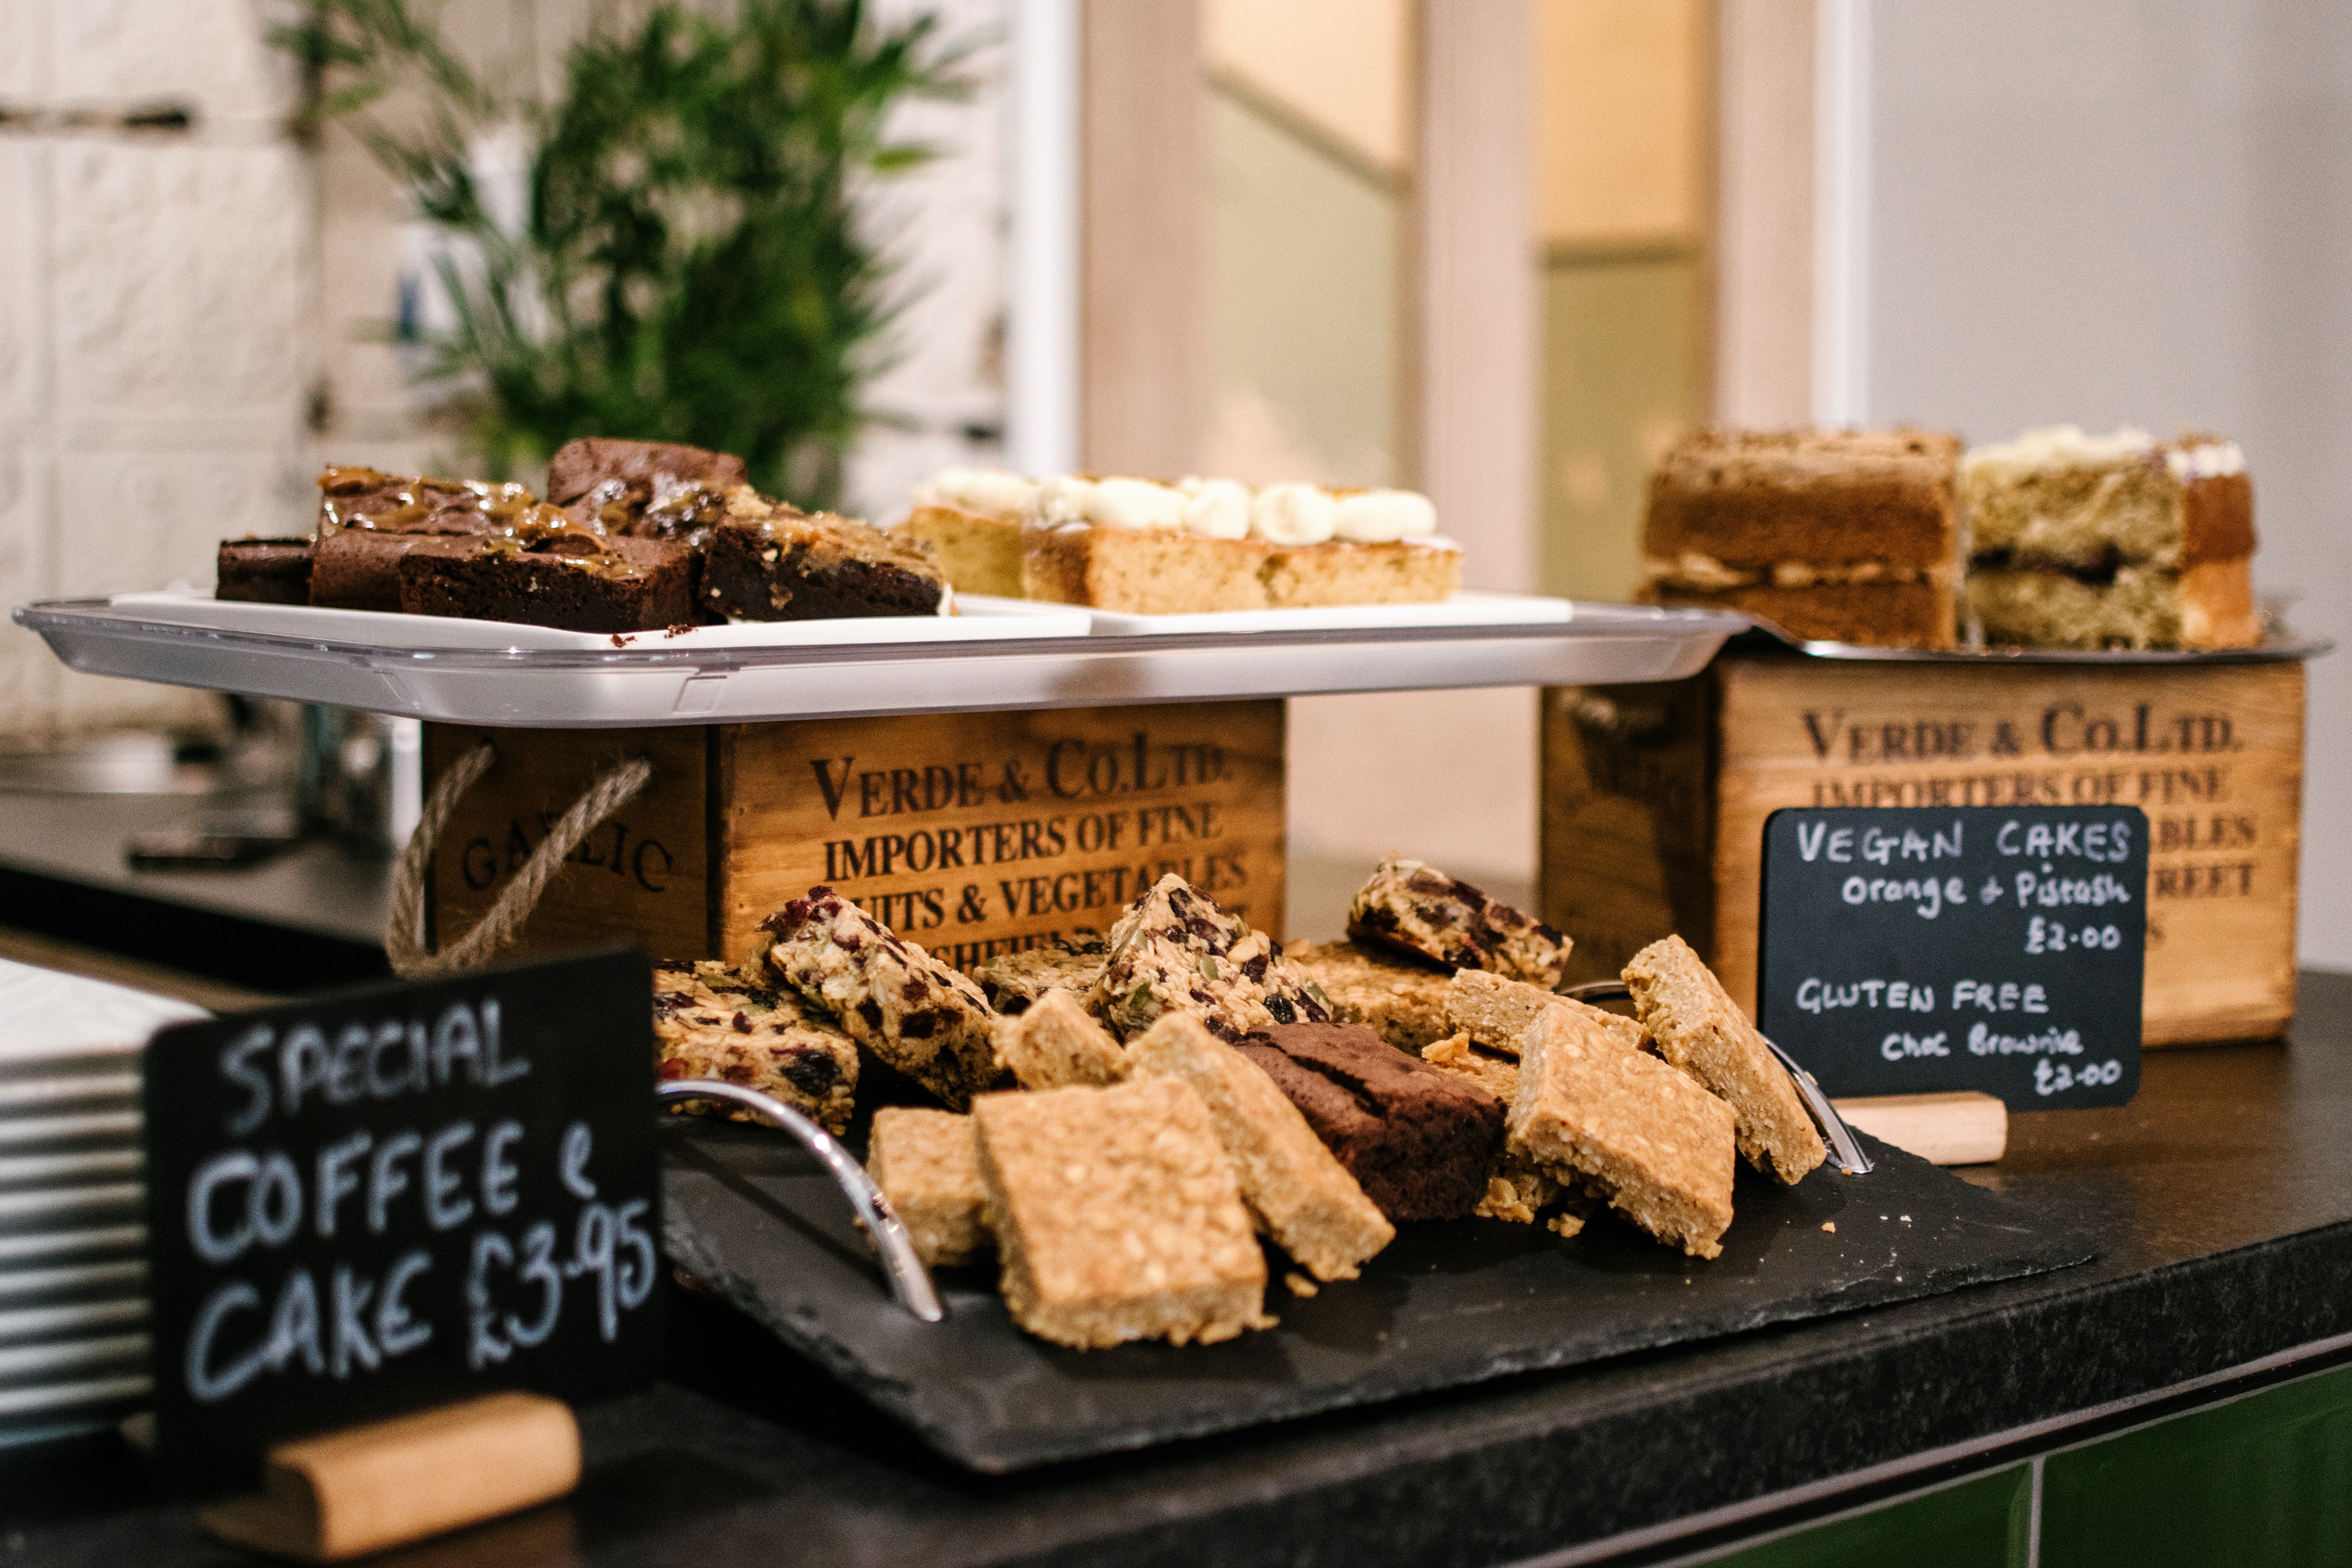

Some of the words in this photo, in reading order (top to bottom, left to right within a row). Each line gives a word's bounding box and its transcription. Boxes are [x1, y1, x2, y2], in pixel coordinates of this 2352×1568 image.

[1803, 710, 1977, 767] VERDE
[1988, 720, 2021, 759] &
[810, 756, 983, 821] VERDE
[998, 760, 1029, 804] &
[823, 817, 1067, 882] IMPORTERS
[1076, 811, 1131, 854] OF
[1138, 802, 1222, 847] FINE
[1797, 820, 1962, 866] VEGAN
[1996, 820, 2132, 862] CAKES
[957, 883, 986, 924] &
[1842, 876, 1967, 920] Orange
[2025, 916, 2122, 955] £2.00
[1796, 977, 1936, 1015] GLUTEN
[1952, 980, 2049, 1014] FREE
[220, 997, 534, 1136] SPECIAL
[185, 1120, 526, 1264] COFFEE
[183, 1251, 436, 1401] CAKE
[466, 1198, 658, 1372] £3.95
